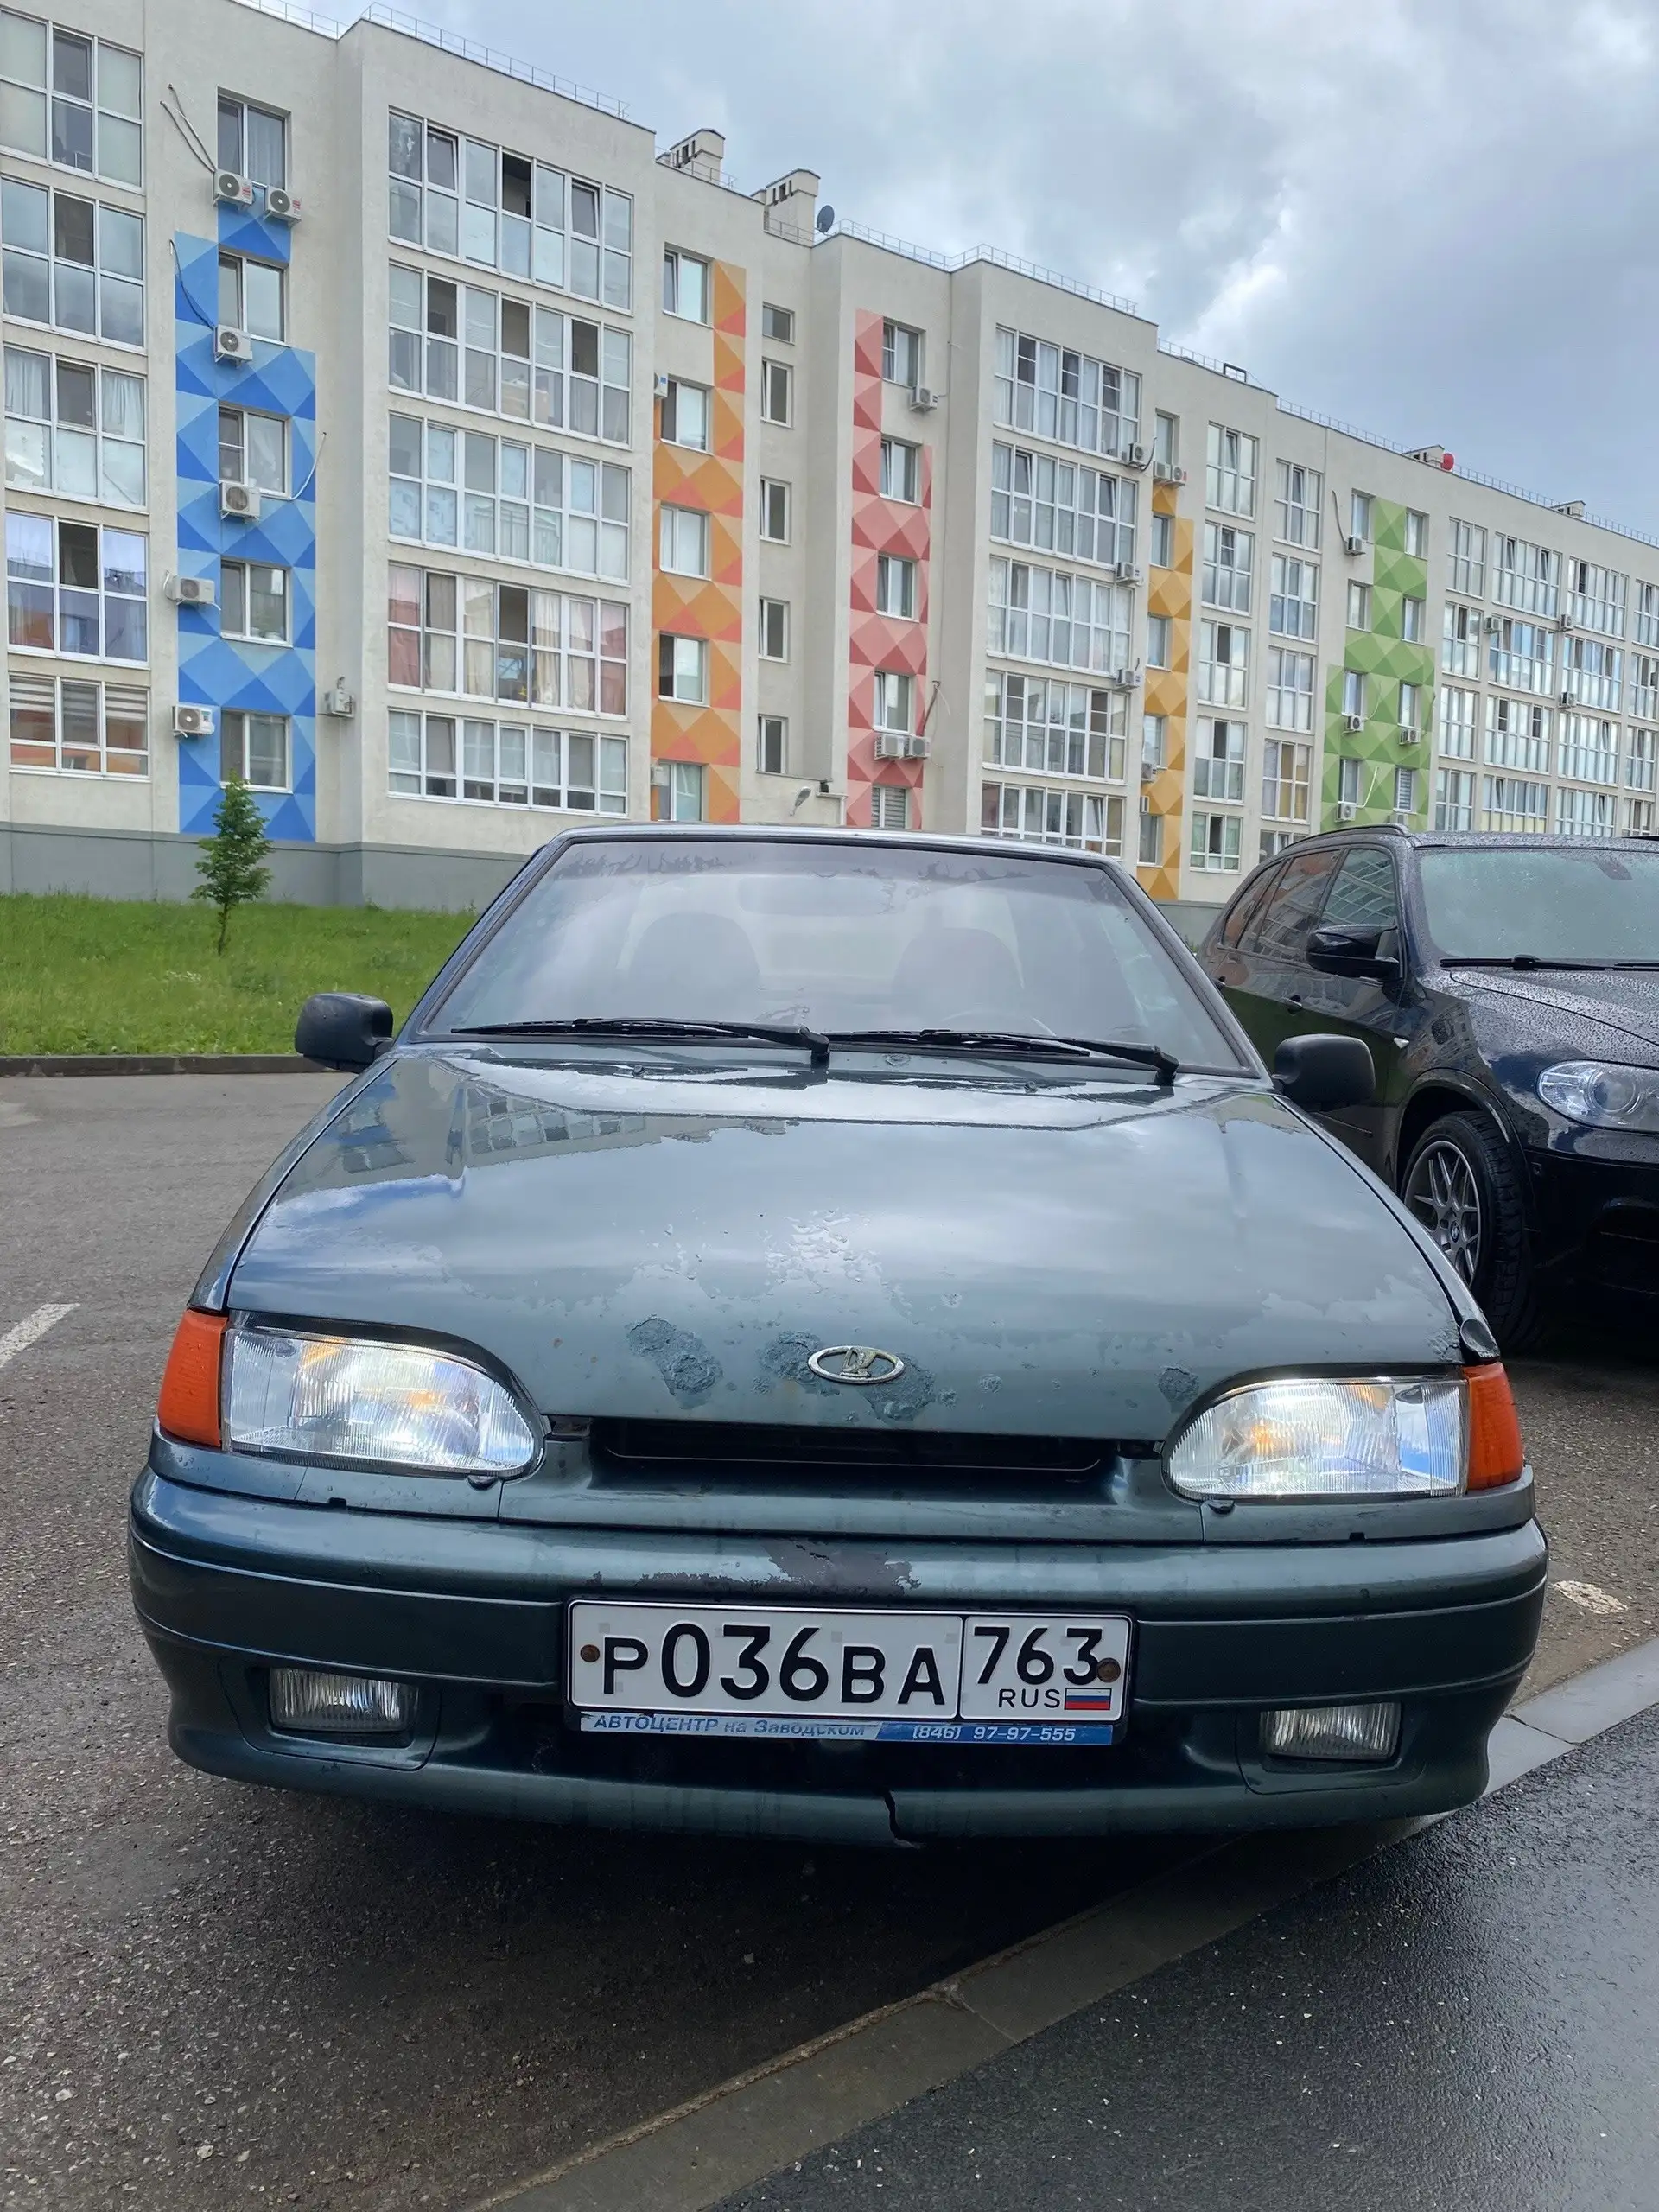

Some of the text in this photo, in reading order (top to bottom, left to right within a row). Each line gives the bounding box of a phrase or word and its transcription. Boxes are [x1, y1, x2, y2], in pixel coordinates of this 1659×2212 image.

[603, 1623, 1103, 1706] Р036ВА 763
[998, 1688, 1061, 1708] RUS
[594, 1714, 1077, 1742] АВТОЦЕНТР на Заводском (846) 97-97-555
